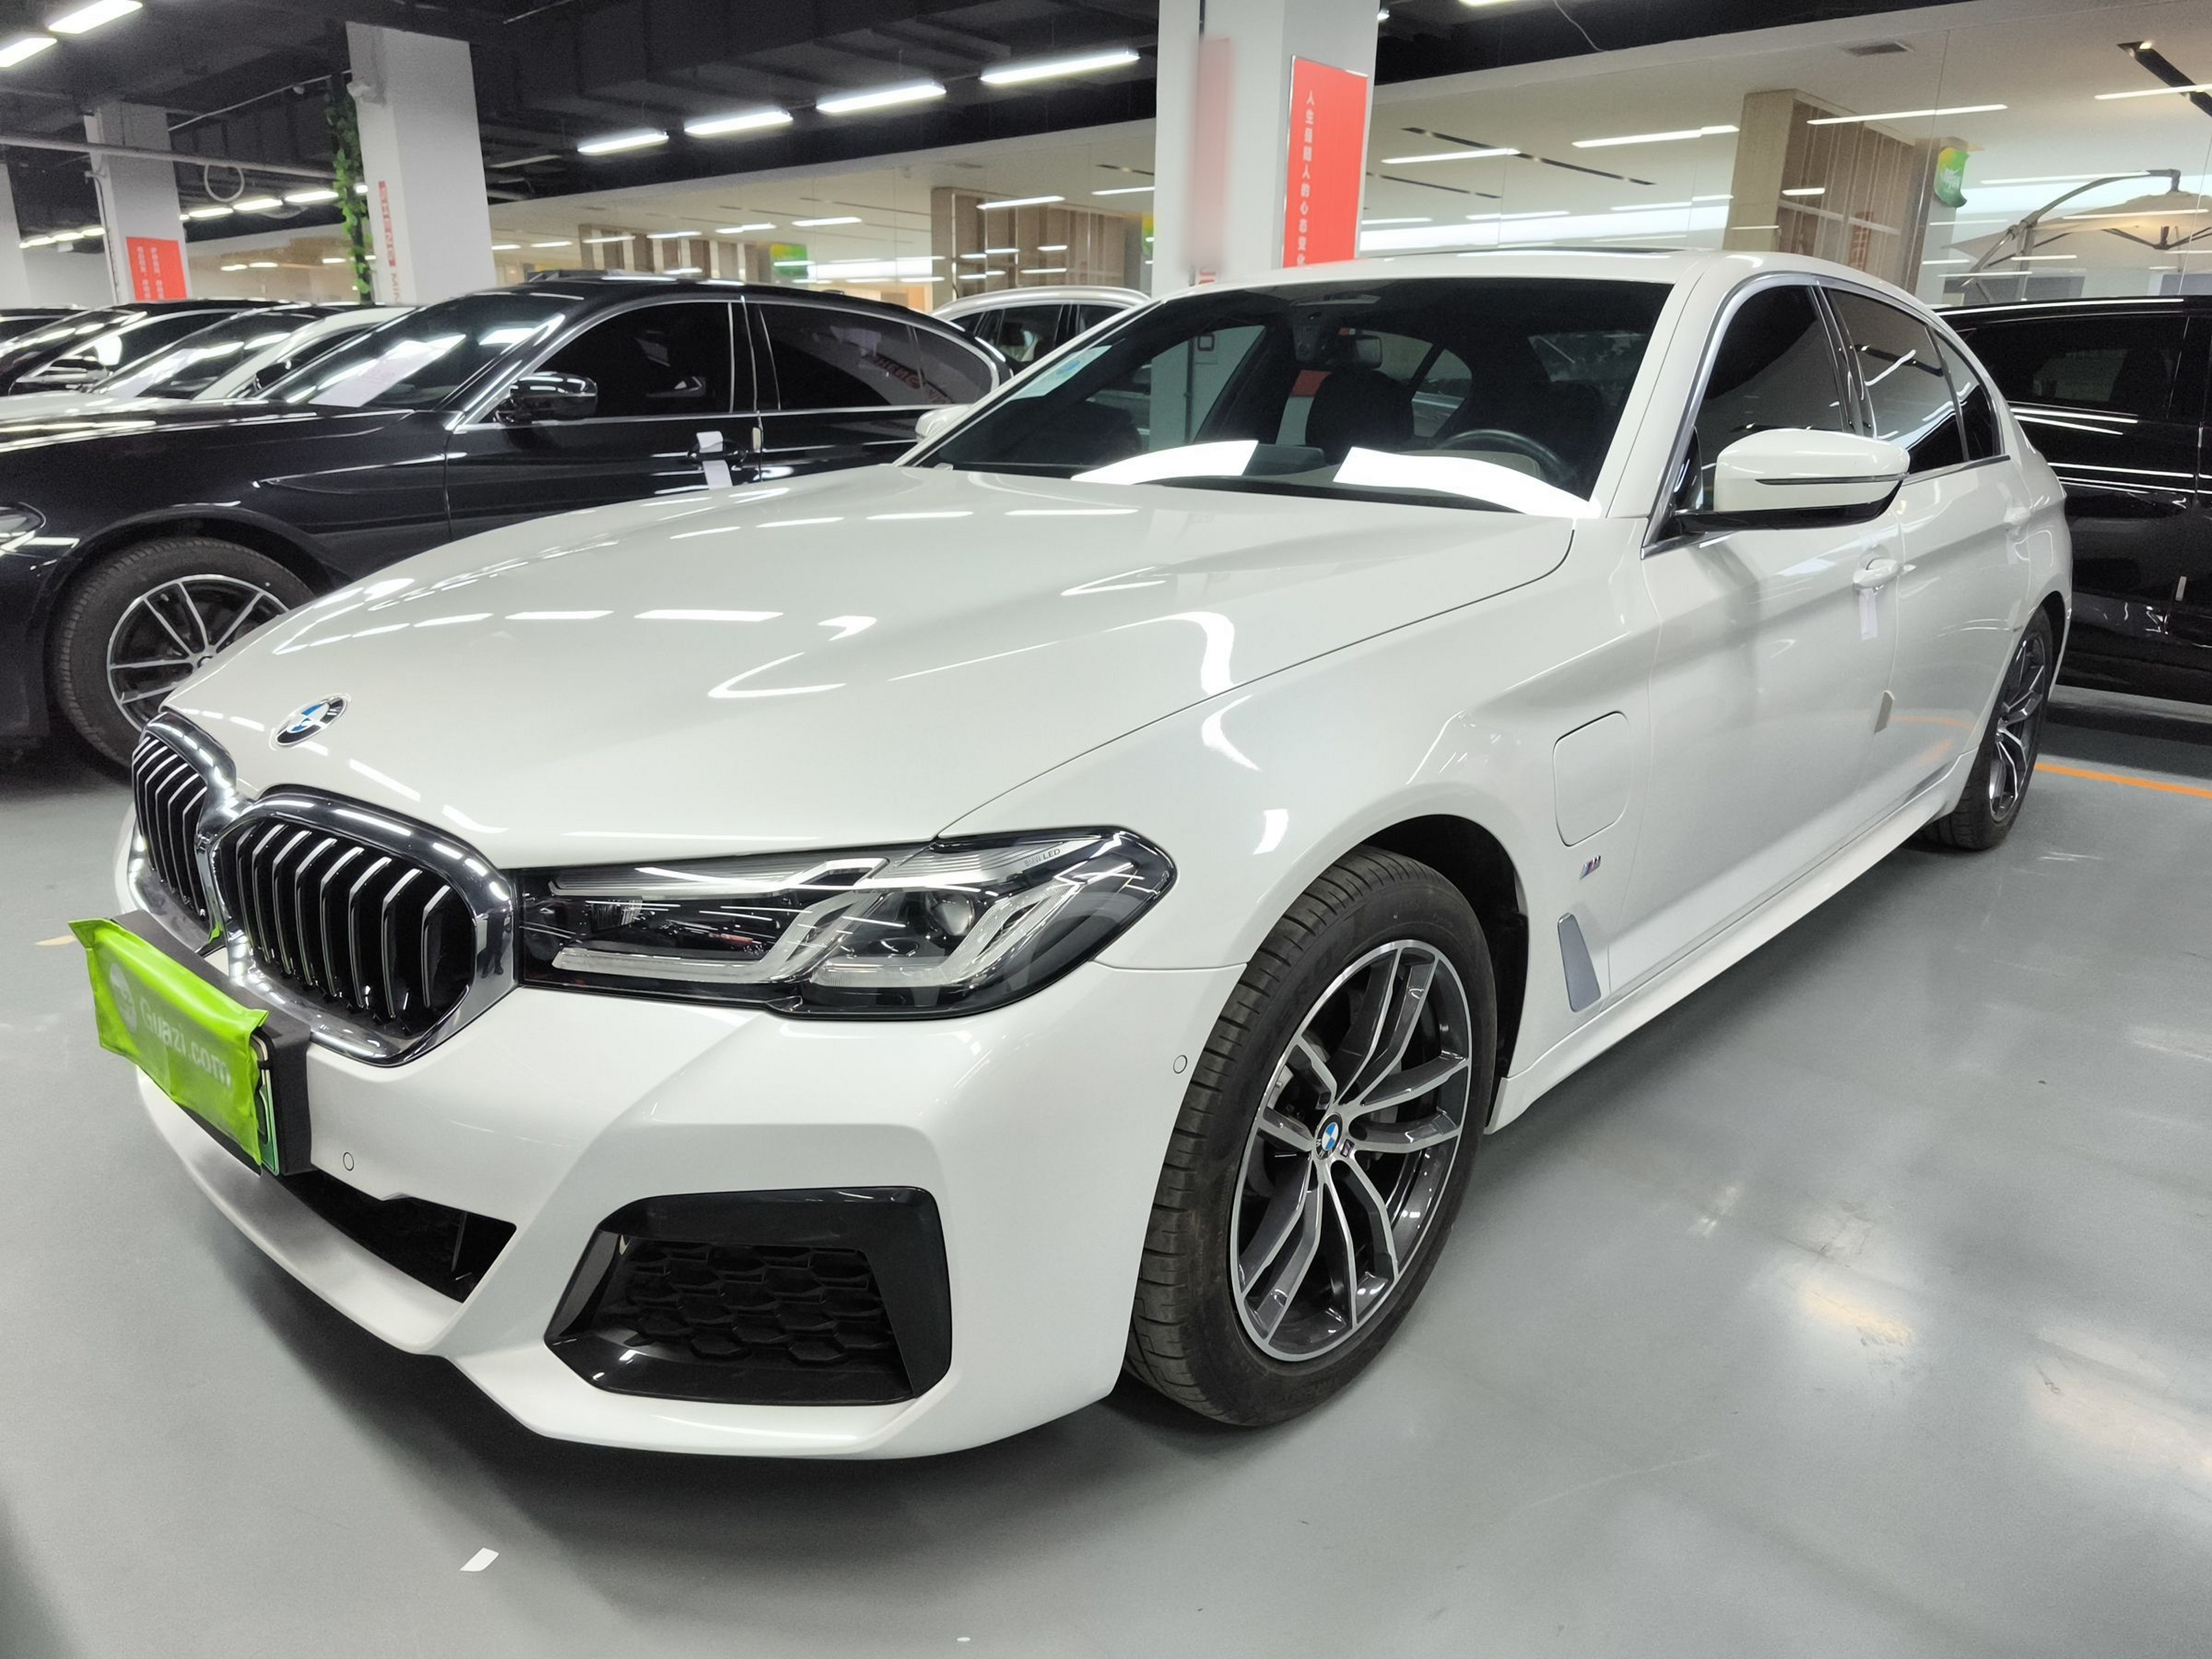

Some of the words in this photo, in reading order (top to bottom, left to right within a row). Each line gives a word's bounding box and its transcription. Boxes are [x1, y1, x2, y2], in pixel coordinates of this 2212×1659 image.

[1024, 855, 1041, 867] BMW
[1043, 848, 1060, 859] LED
[139, 997, 231, 1090] Guazi.com
